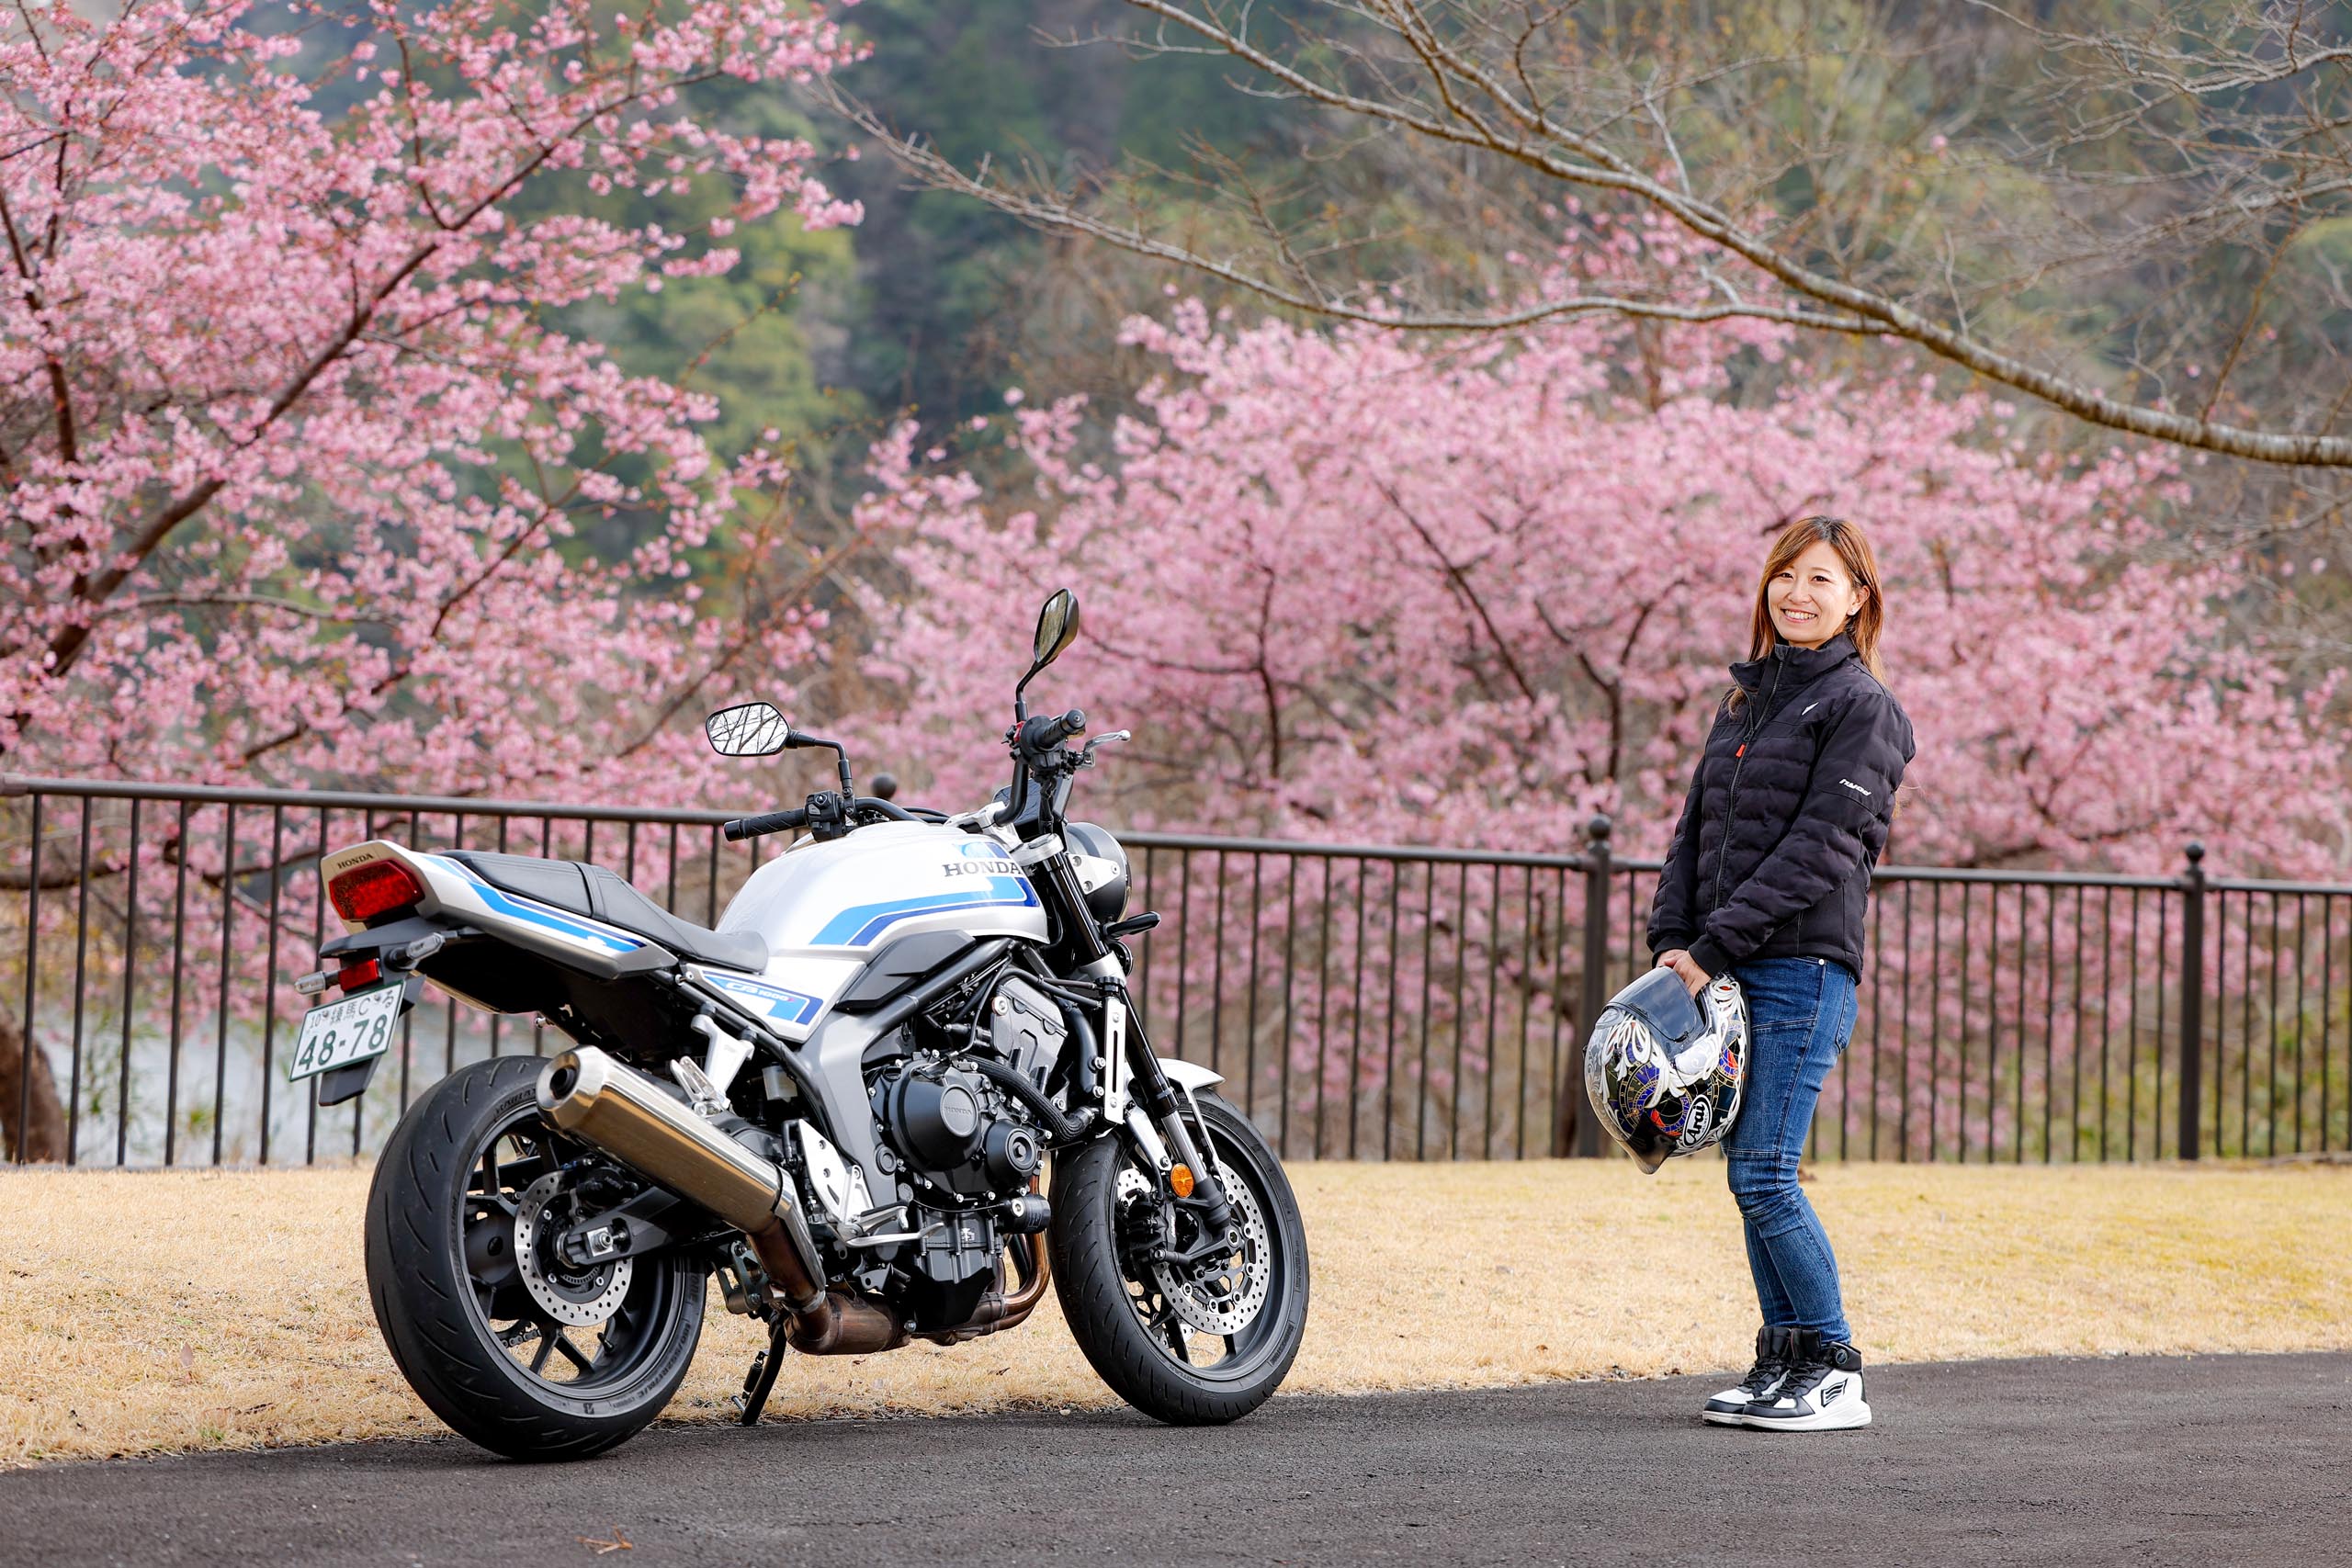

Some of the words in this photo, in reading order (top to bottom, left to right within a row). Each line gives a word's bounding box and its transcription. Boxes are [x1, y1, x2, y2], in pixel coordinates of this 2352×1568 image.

[336, 852, 374, 869] HONDA
[942, 862, 1024, 877] HONDA
[299, 1014, 389, 1071] 48-78
[1686, 1103, 1706, 1145] Arai
